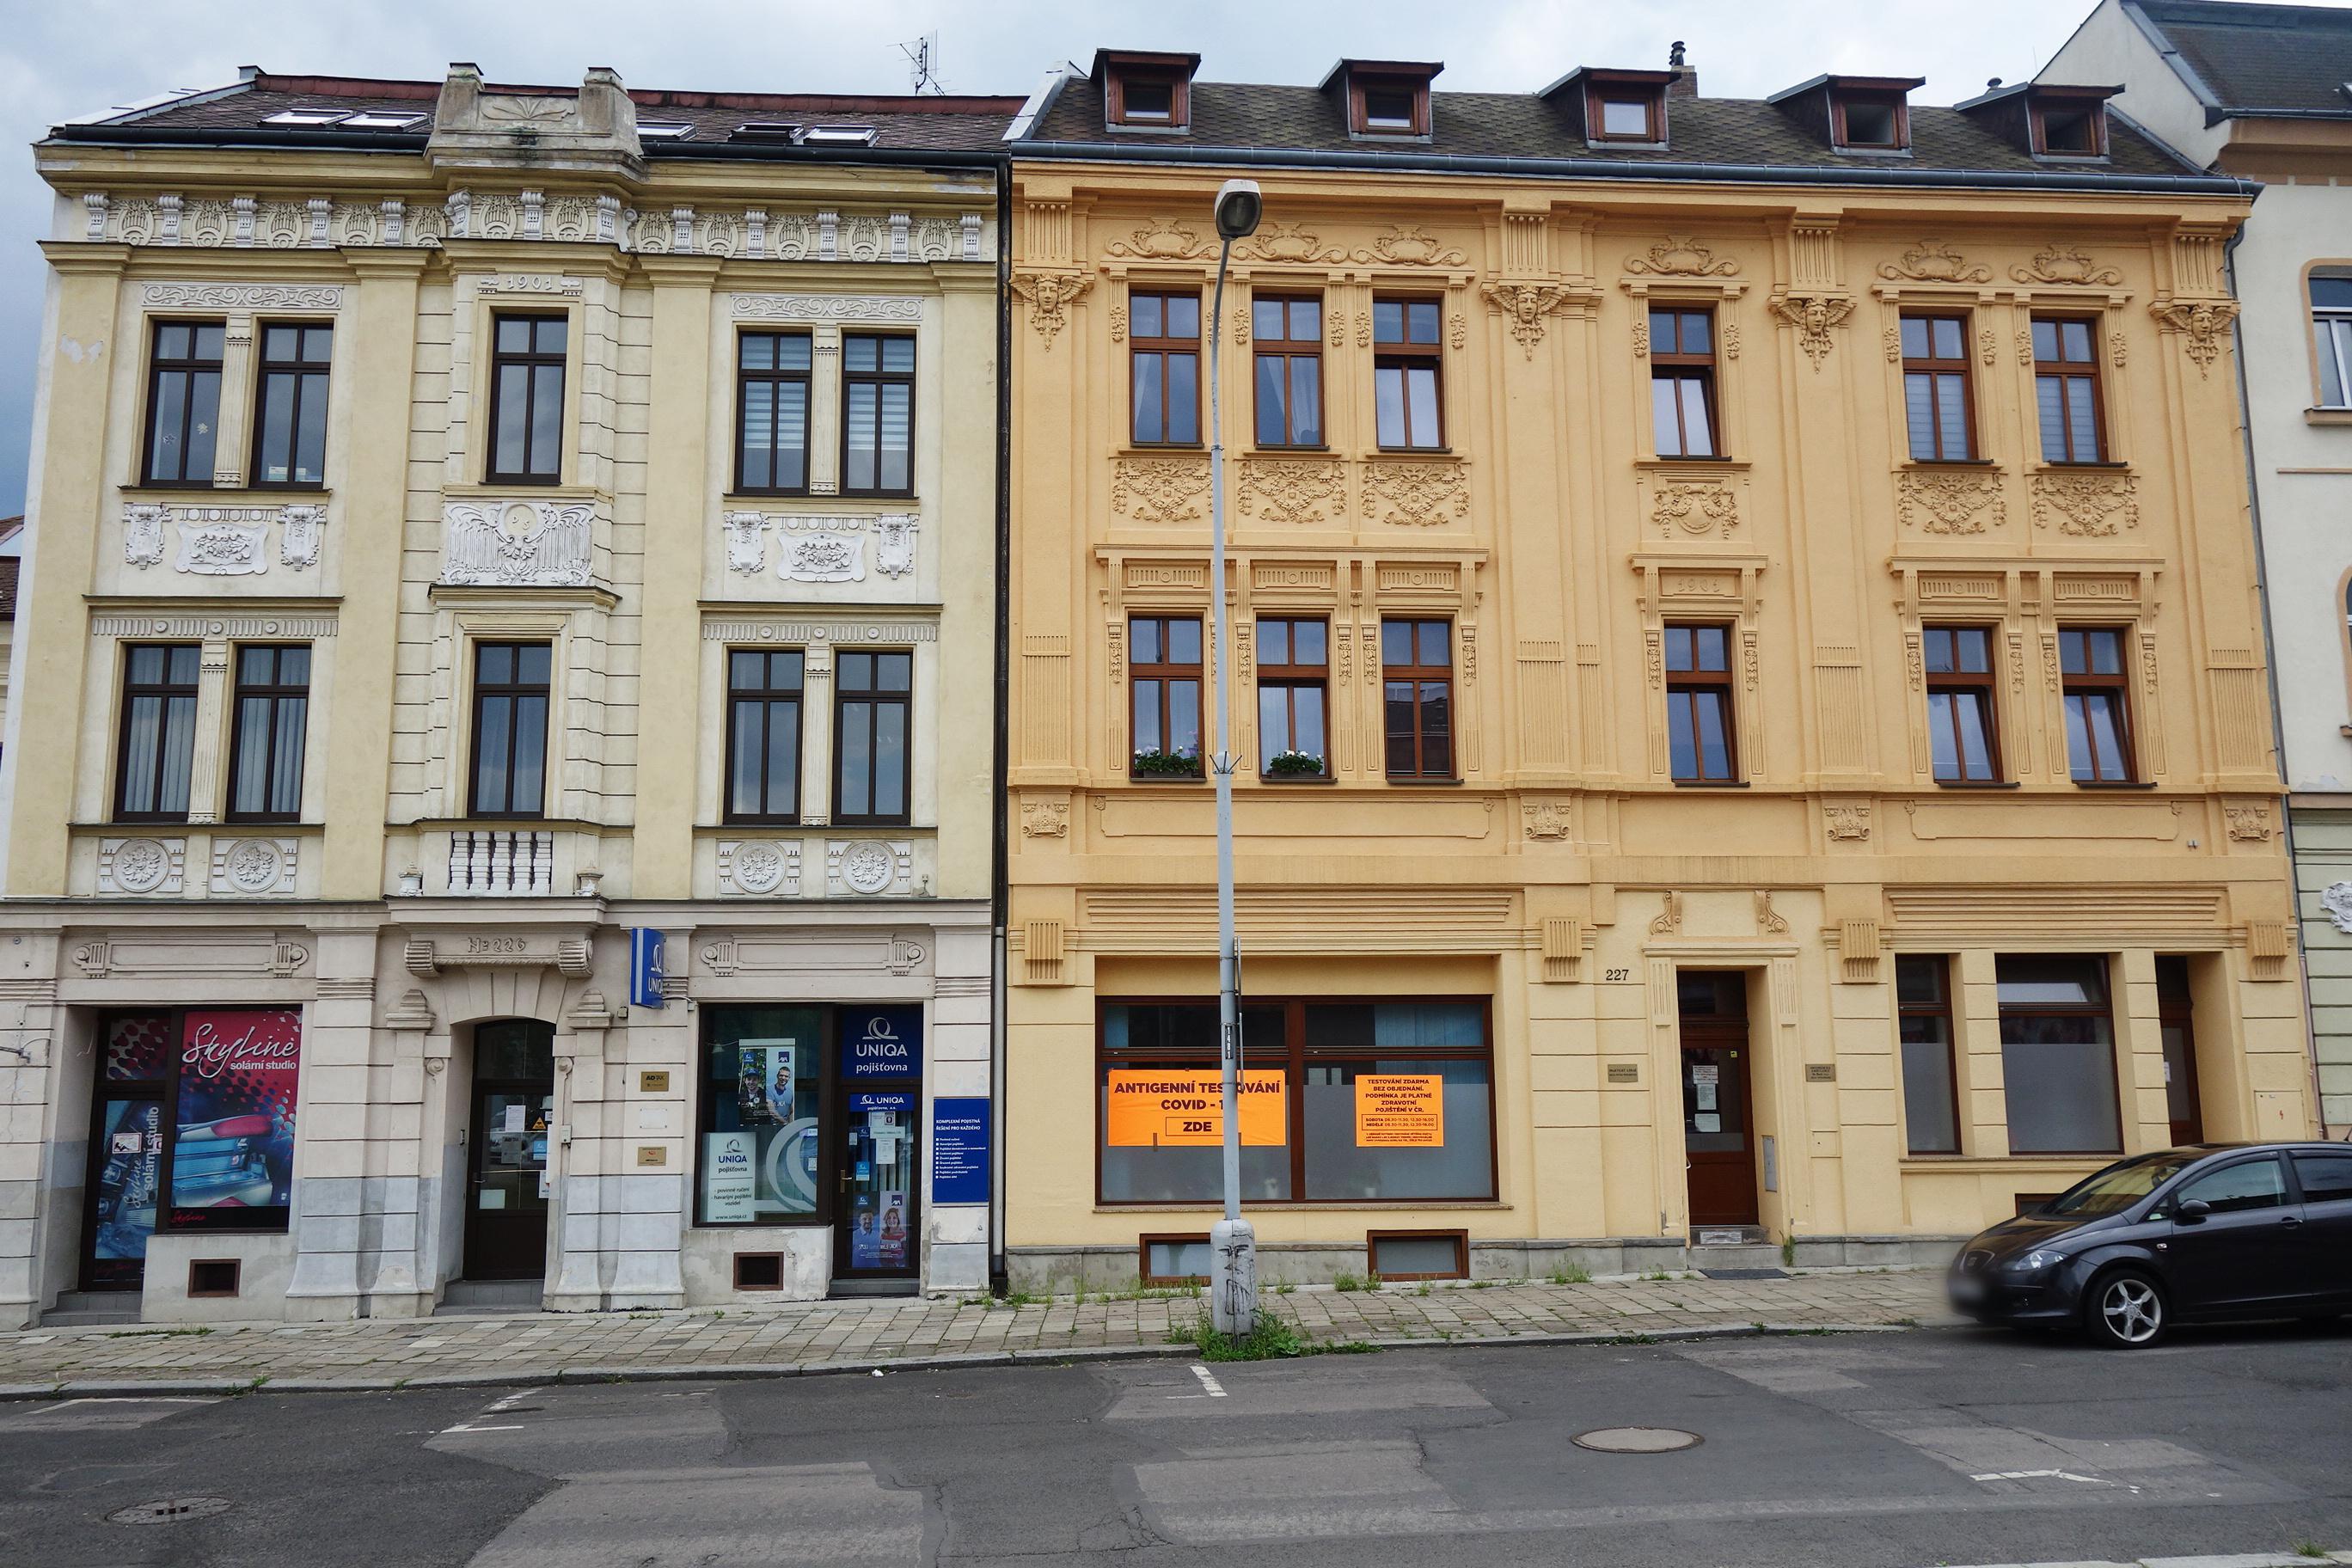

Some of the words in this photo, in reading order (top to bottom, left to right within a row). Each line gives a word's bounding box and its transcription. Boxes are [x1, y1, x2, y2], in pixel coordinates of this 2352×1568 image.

[507, 276, 552, 291] 1901
[493, 937, 526, 952] 226
[1606, 969, 1629, 981] 227
[855, 1044, 908, 1057] UNIQA
[230, 1060, 264, 1070] solární
[266, 1060, 297, 1070] studio
[856, 1063, 908, 1075] pojišťovna
[1114, 1081, 1197, 1093] ANTIGENNÍ
[1198, 1081, 1281, 1093] TESOVÁNÍ
[1161, 1099, 1207, 1111] COVID
[1183, 1121, 1212, 1132] ZDE
[718, 1166, 747, 1174] pojišťovna
